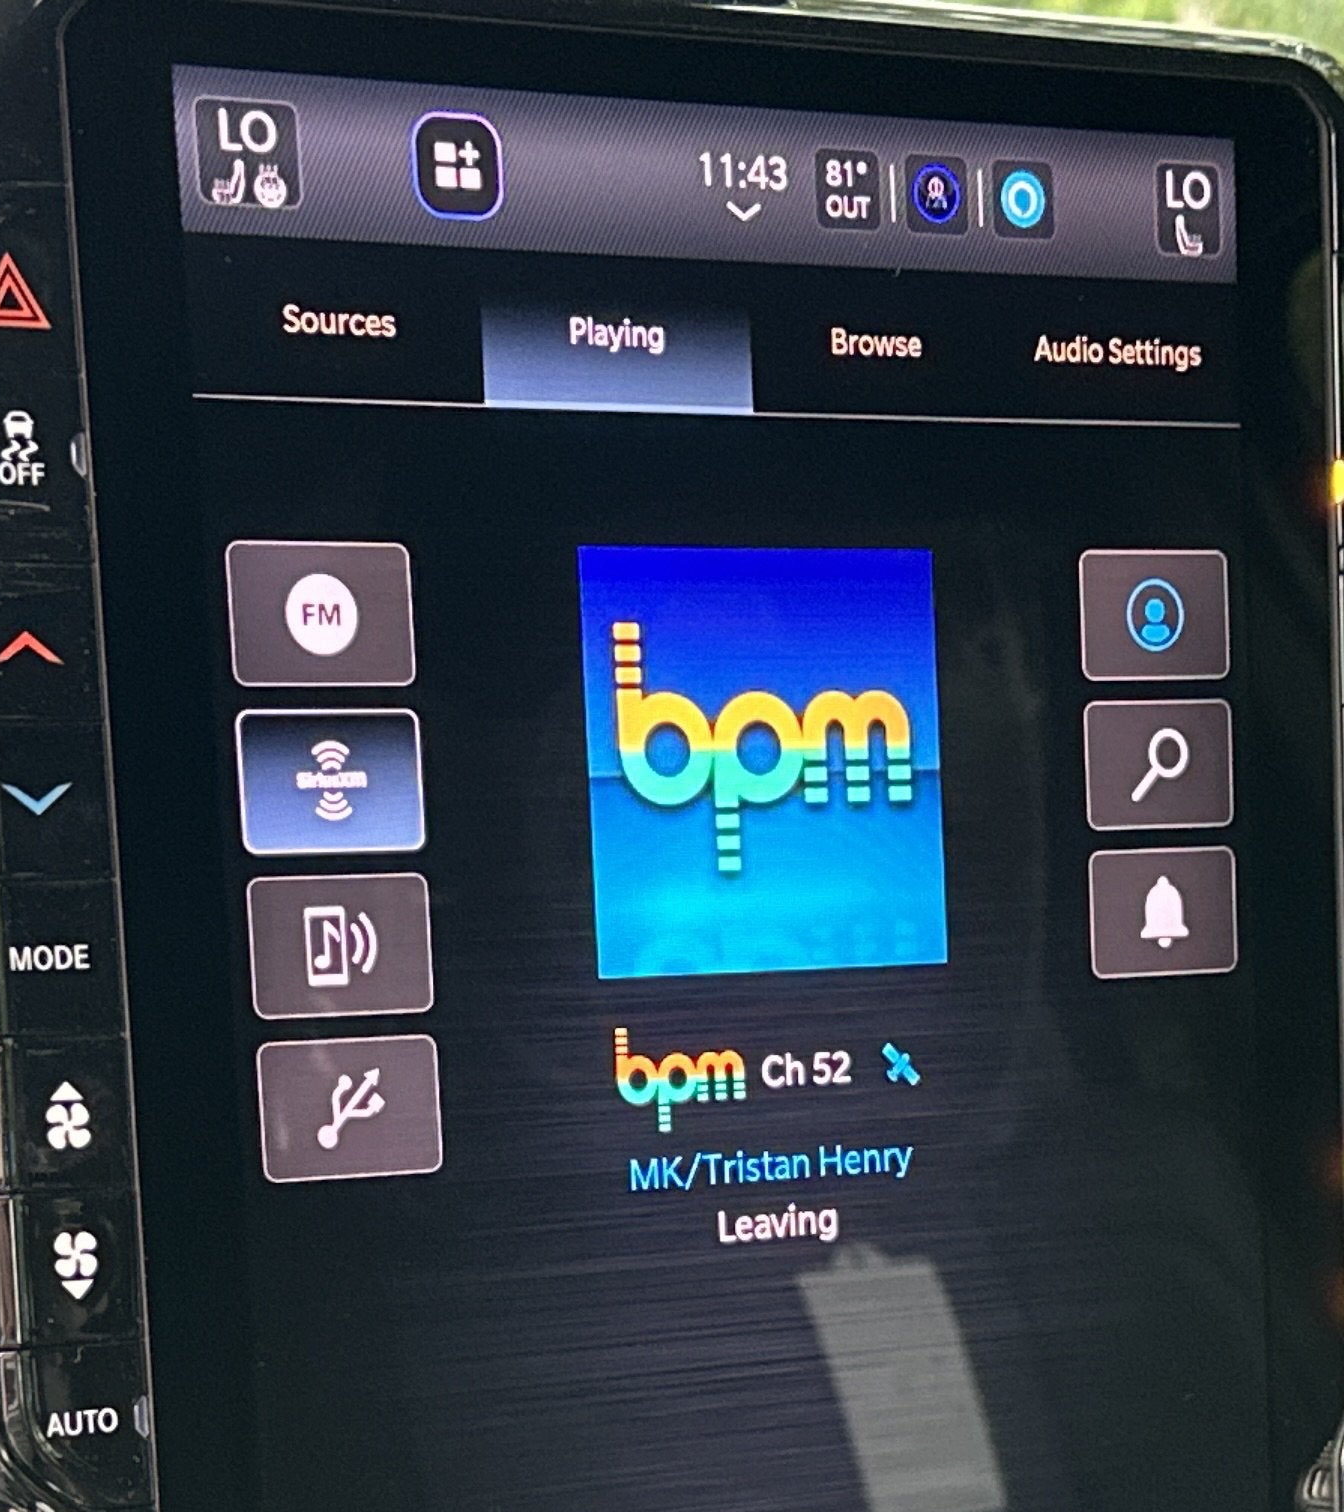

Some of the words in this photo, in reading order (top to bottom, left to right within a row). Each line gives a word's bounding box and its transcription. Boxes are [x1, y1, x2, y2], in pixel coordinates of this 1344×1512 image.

[216, 107, 278, 153] LO
[698, 150, 789, 192] 11:43
[1164, 168, 1212, 212] LO
[825, 193, 871, 220] OUT
[282, 304, 397, 337] Sources
[569, 316, 665, 354] Playing
[830, 328, 923, 358] Browse
[1034, 334, 1104, 366] Audio
[1108, 336, 1202, 372] Settings
[301, 603, 342, 625] FM
[612, 621, 911, 872] bpm
[9, 944, 92, 972] MODE
[614, 1027, 746, 1133] bpm
[761, 1054, 806, 1088] Ch
[812, 1052, 852, 1084] 52
[628, 1152, 812, 1194] MK/Tristan
[818, 1144, 914, 1180] Henry
[717, 1204, 840, 1245] Leaving
[46, 1408, 119, 1436] AUTO
